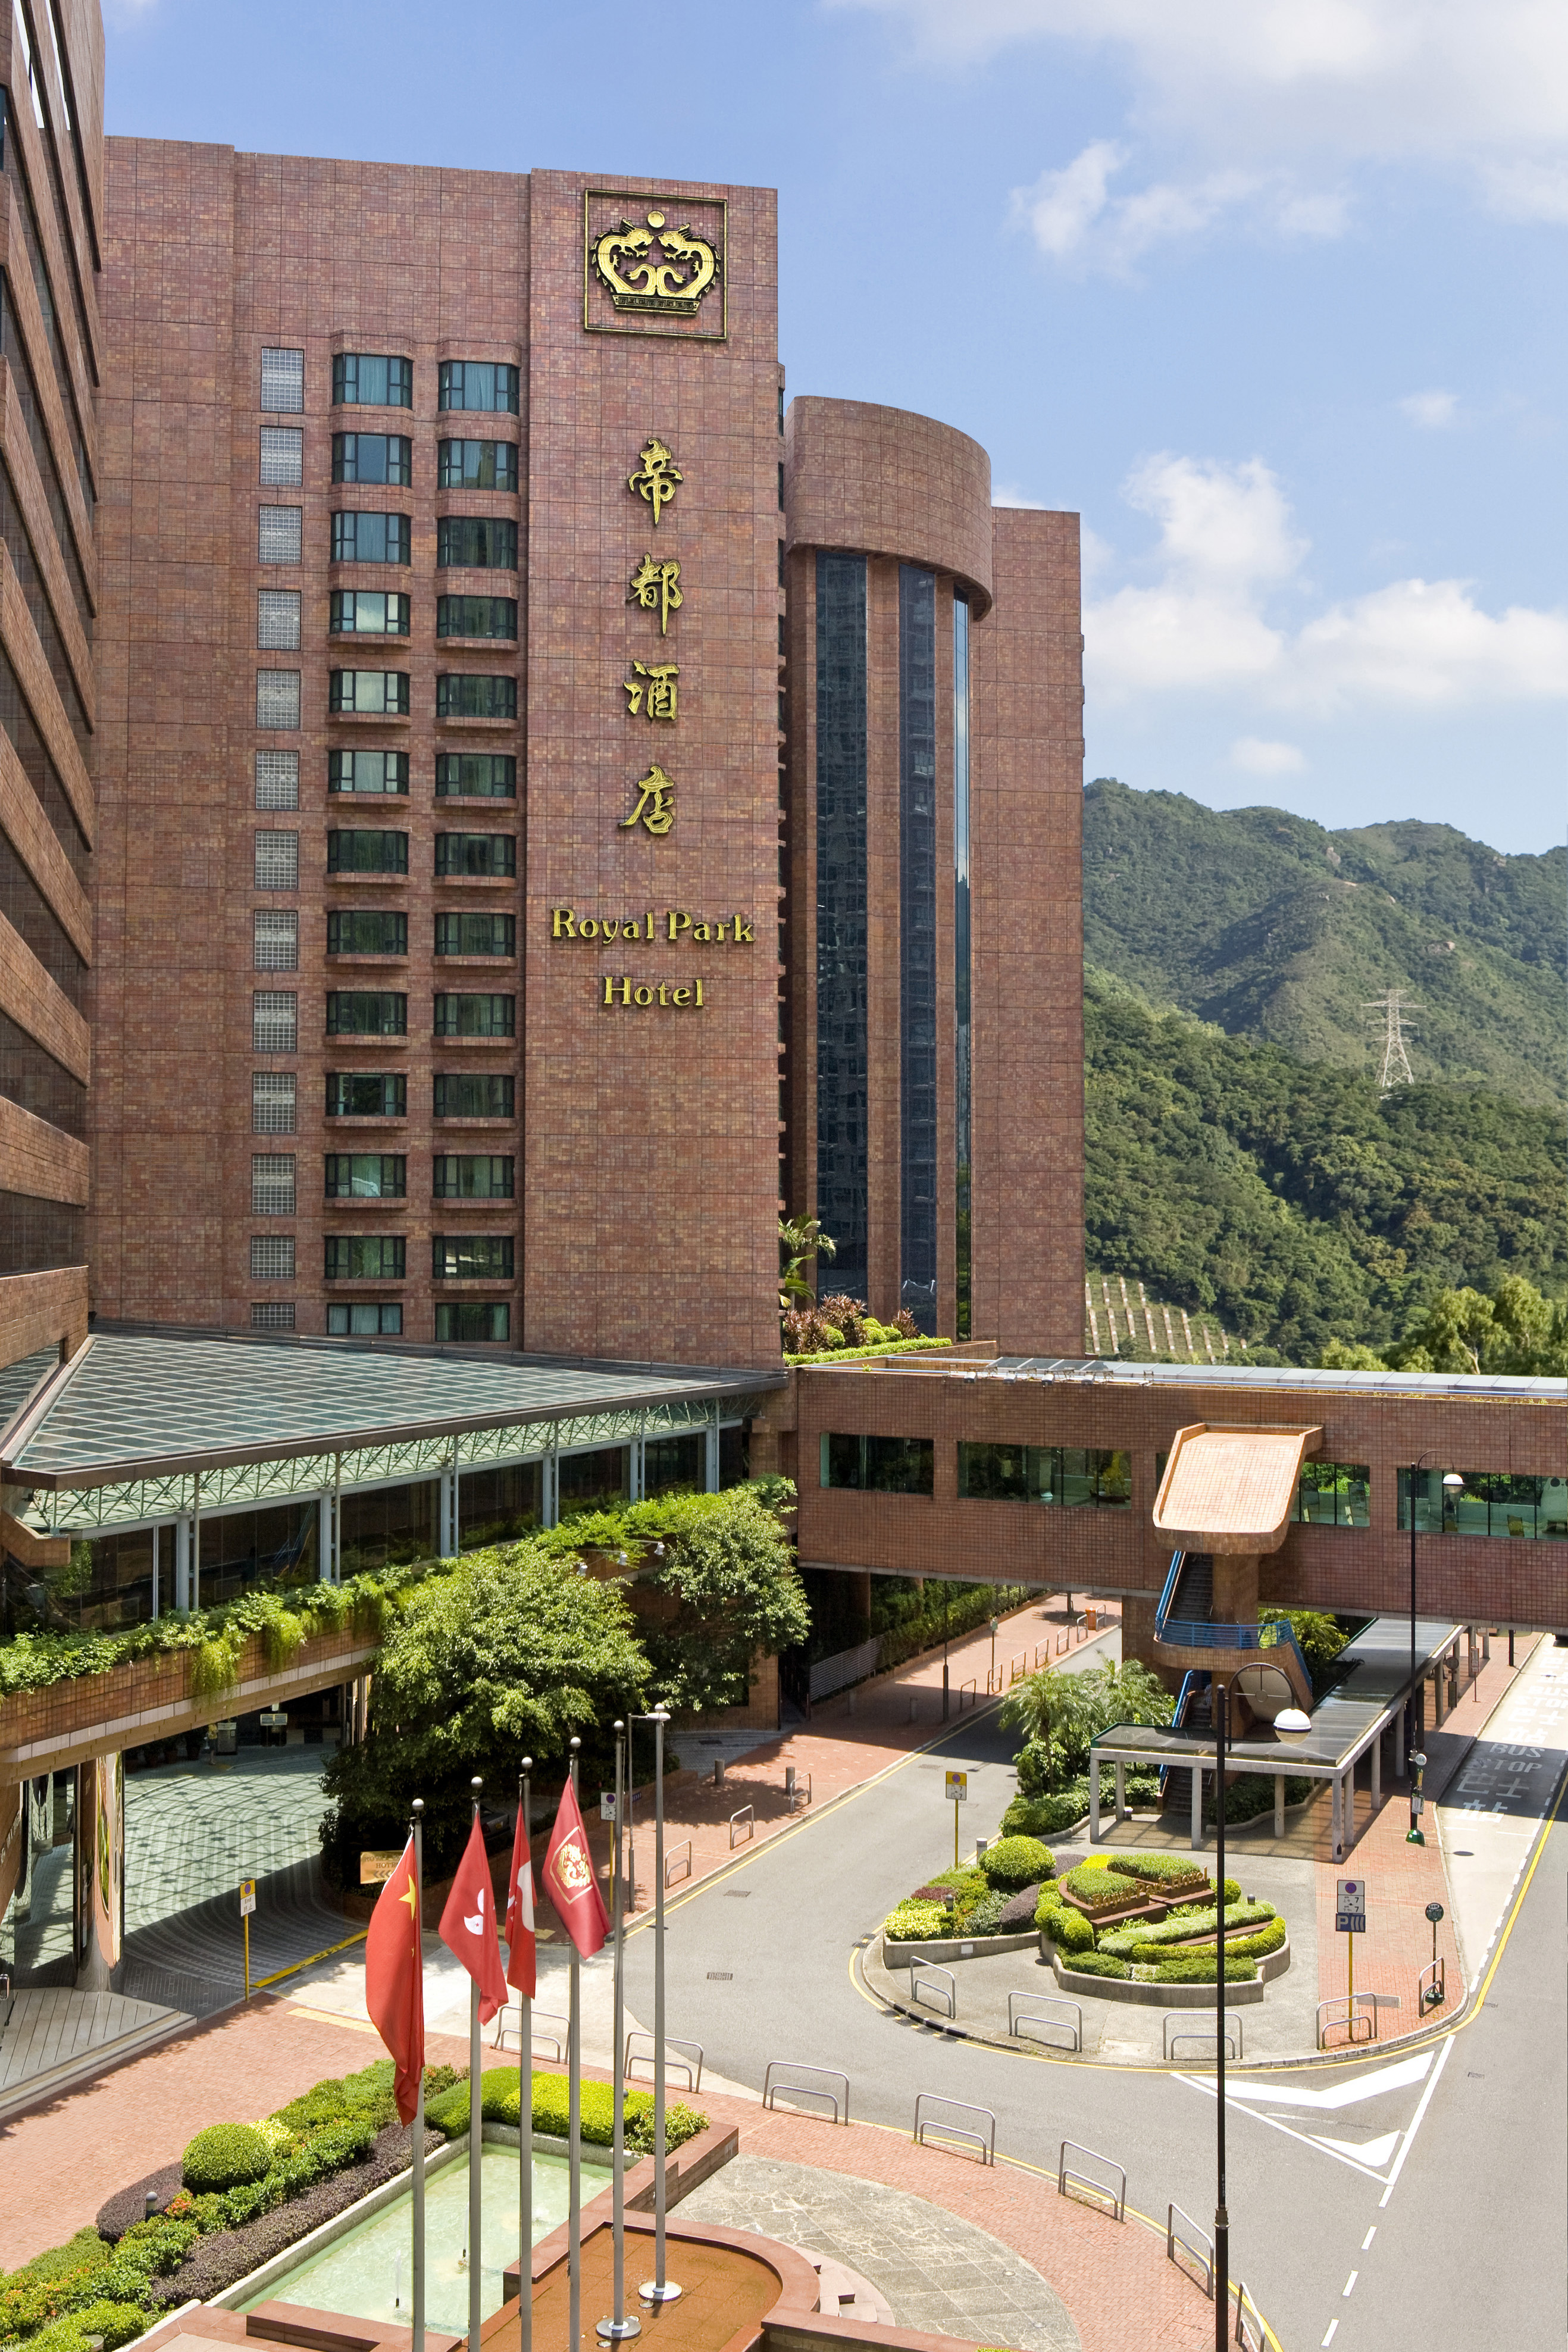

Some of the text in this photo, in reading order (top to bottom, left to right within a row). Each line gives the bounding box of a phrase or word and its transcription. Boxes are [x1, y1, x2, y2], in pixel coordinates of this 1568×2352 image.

[618, 437, 684, 834] 帝都酒店
[552, 908, 756, 944] Royal Park
[603, 976, 705, 1006] Hotel
[1508, 1707, 1564, 1726] 巴士
[1502, 1727, 1548, 1744] 站
[1489, 1743, 1545, 1758] BUS
[1456, 1773, 1530, 1799] 巴士
[1456, 1799, 1508, 1824] 站
[1092, 1866, 1207, 1910] Royal Park Hotel
[1337, 1915, 1349, 1930] P
